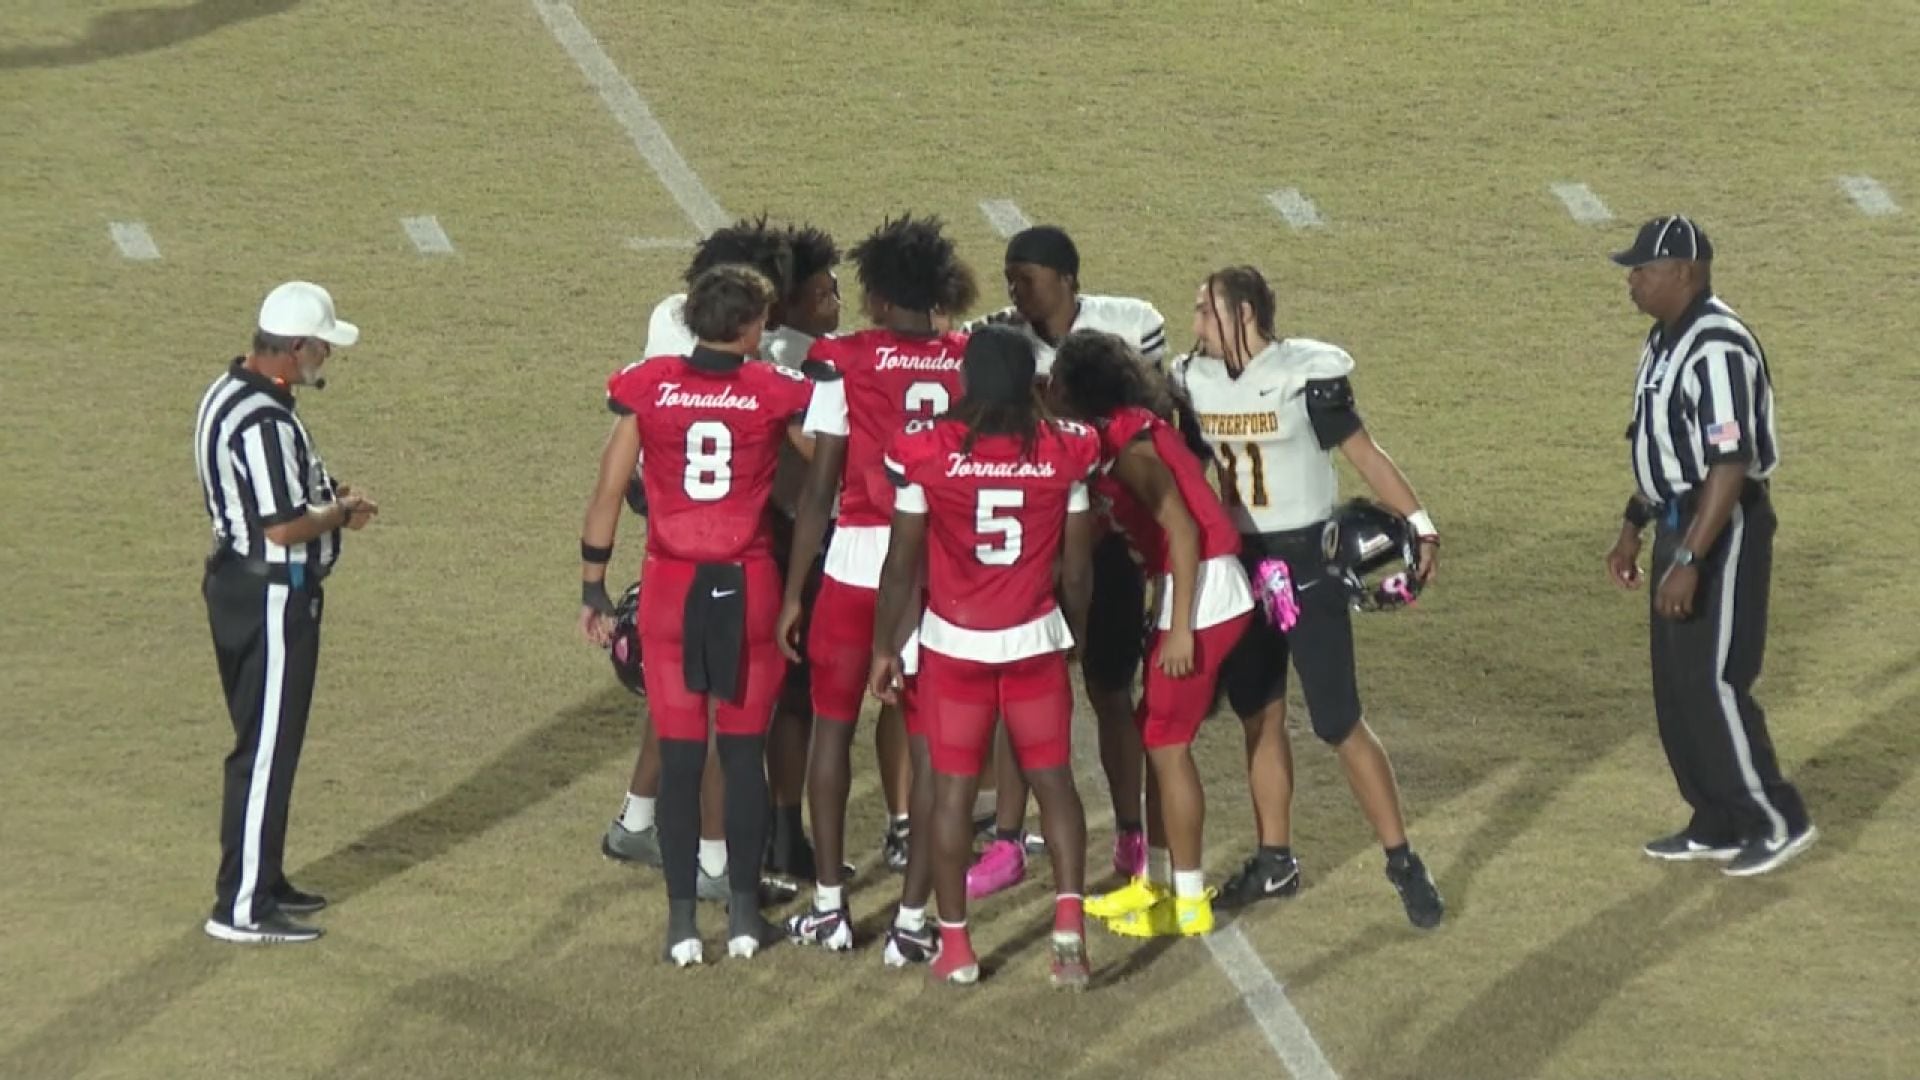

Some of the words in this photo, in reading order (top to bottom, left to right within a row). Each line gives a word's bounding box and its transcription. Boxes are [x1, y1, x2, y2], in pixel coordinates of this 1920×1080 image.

[655, 381, 760, 411] Tornadoes
[1199, 411, 1279, 436] UTHERFORD
[683, 420, 733, 501] 8
[975, 488, 1024, 566] 5
